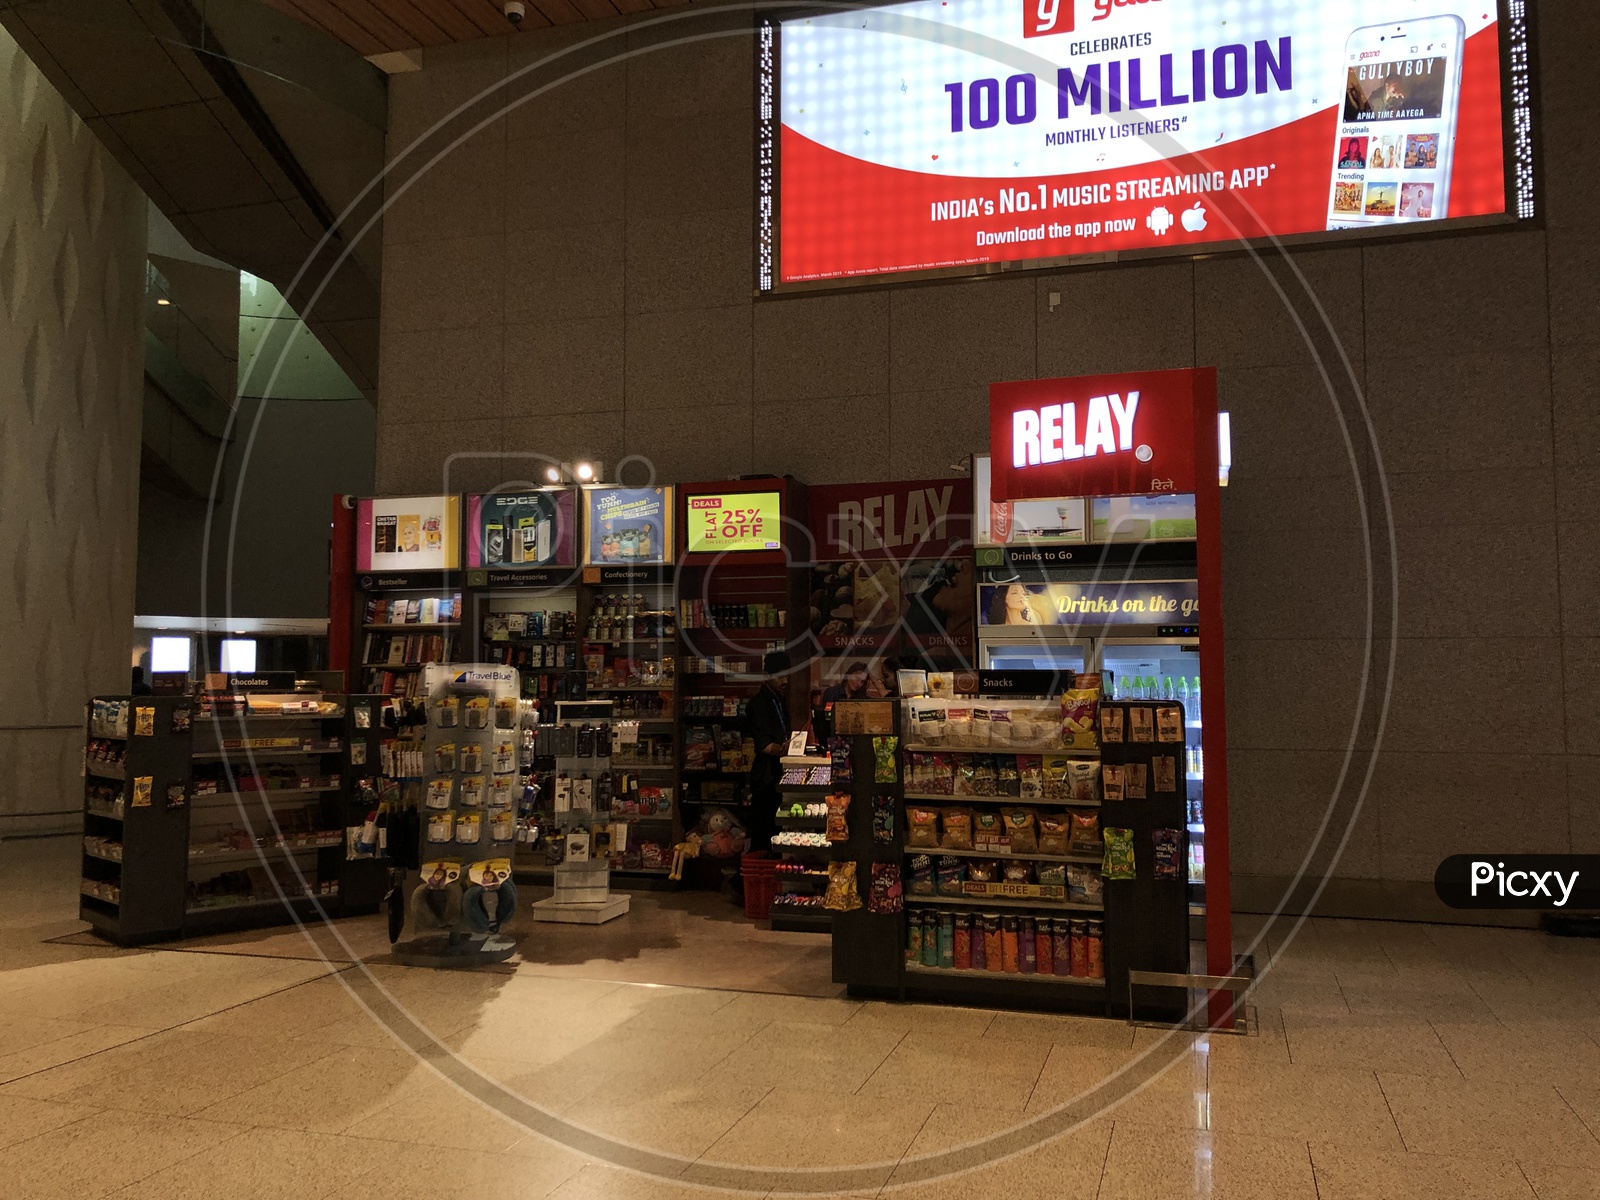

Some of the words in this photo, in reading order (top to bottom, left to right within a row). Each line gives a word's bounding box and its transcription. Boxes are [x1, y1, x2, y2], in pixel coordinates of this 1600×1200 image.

[1070, 32, 1152, 56] CELEBRATES
[944, 73, 1037, 132] 100
[1057, 36, 1292, 120] MILLION
[1357, 112, 1375, 120] APNA
[1378, 110, 1394, 119] TIME
[1395, 108, 1424, 118] AAYEGA
[1342, 126, 1370, 135] Originals
[1045, 126, 1106, 147] MONTHLY
[1337, 173, 1364, 181] Trending
[999, 184, 1047, 214] No.1
[1052, 183, 1111, 208] MUSIC
[1115, 170, 1225, 202] STREAMING
[976, 224, 1045, 246] Download
[1048, 223, 1071, 239] the
[1075, 222, 1101, 239] app
[1105, 218, 1136, 233] now
[1012, 390, 1140, 469] RELAY
[496, 496, 538, 506] EDGE
[722, 508, 763, 524] 25%
[838, 486, 954, 554] RELAY
[705, 511, 717, 539] FLAT
[721, 524, 763, 538] OFF
[1011, 551, 1042, 561] Drinks
[1045, 552, 1056, 560] to
[1058, 551, 1073, 561] Go
[490, 574, 510, 582] Travel
[511, 573, 548, 582] Accessories
[604, 571, 648, 580] Confectionery
[1057, 595, 1120, 614] Drinks
[1122, 599, 1146, 613] on
[1149, 595, 1179, 613] the
[834, 637, 875, 646] SNACKS
[929, 636, 968, 646] DRINKS
[230, 678, 269, 686] Chocolates
[983, 677, 1013, 688] Snacks
[254, 739, 276, 747] FREE
[1002, 884, 1029, 895] FREE
